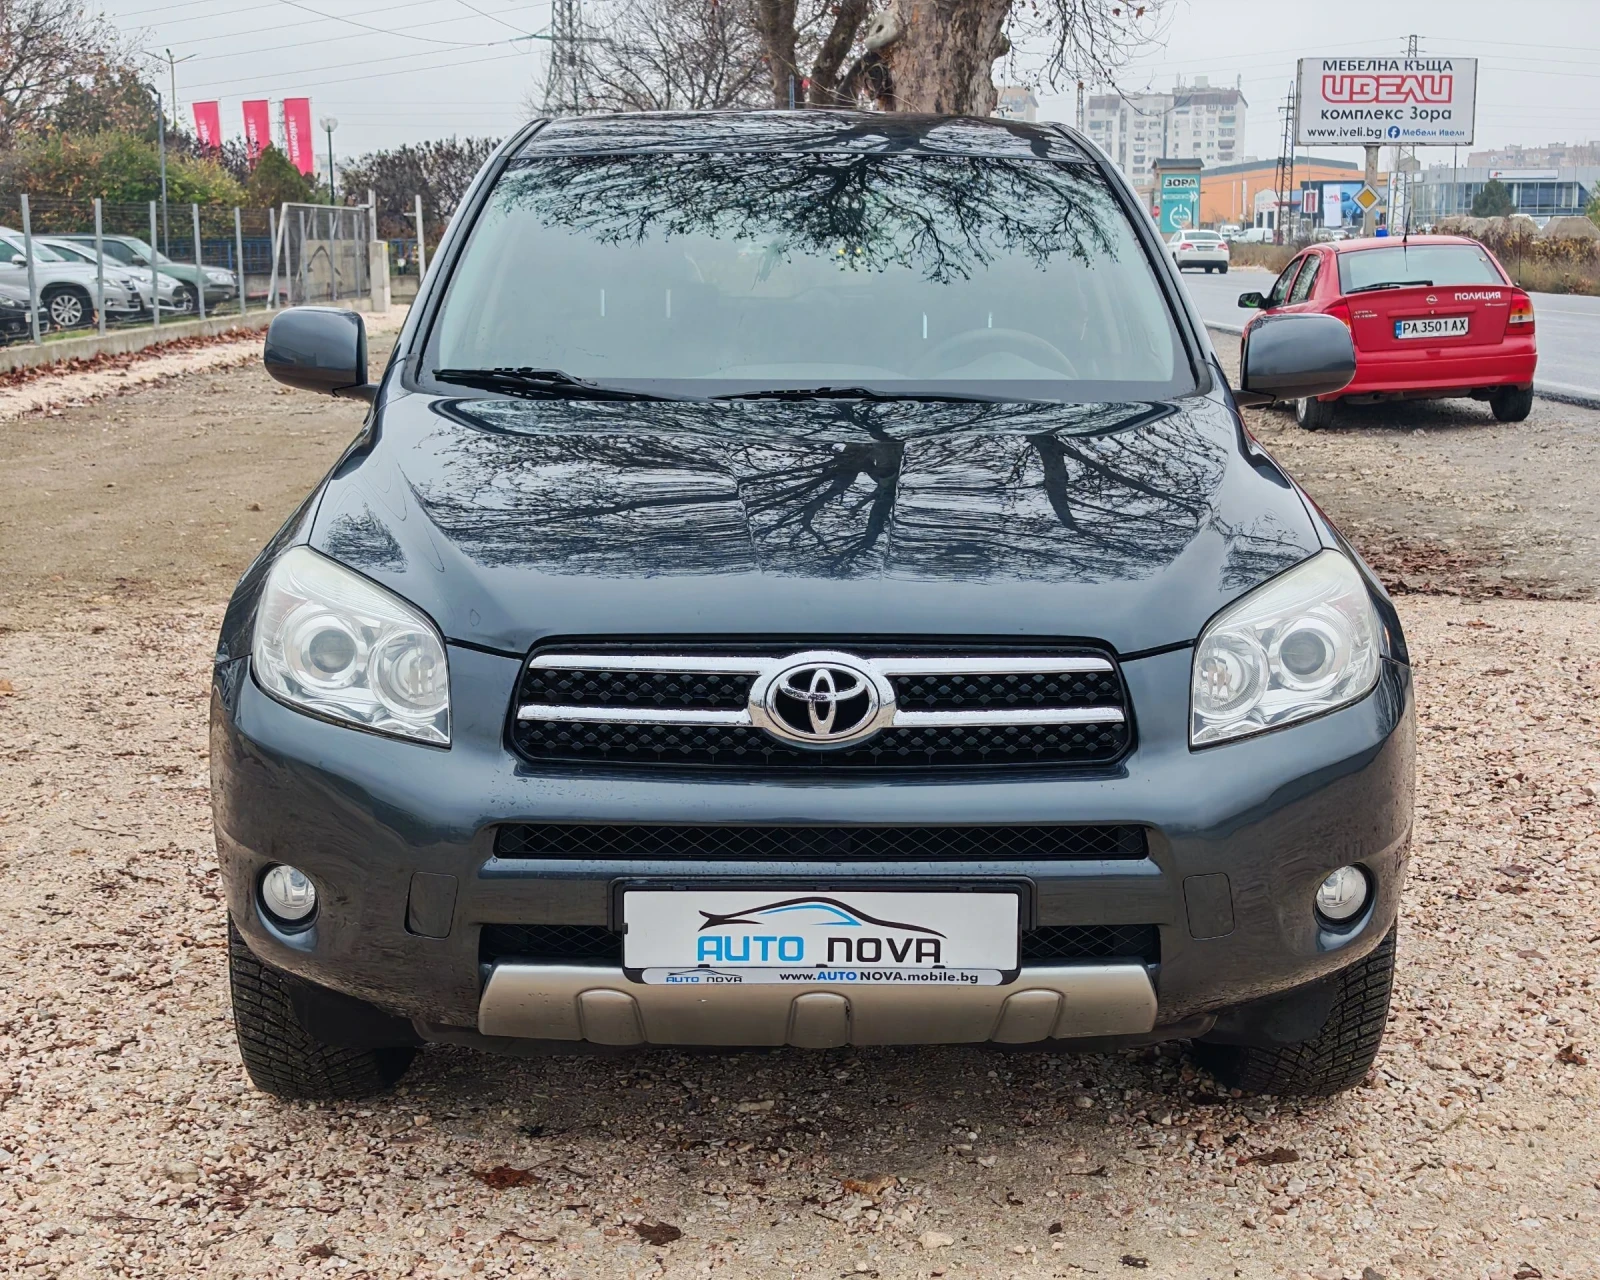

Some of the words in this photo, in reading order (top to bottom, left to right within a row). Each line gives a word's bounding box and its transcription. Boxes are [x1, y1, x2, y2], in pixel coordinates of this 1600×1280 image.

[1322, 60, 1399, 71] МЕБЕЛНА
[1404, 60, 1453, 73] КЪЩА
[1321, 75, 1453, 103] ИВЕЛИ
[1321, 108, 1404, 120] комплекс
[1410, 106, 1452, 123] Зора
[1307, 126, 1382, 139] www.iveli.bg
[1164, 178, 1198, 187] ЗОРА
[1454, 291, 1501, 301] ПОЛИЦИЯ
[697, 936, 804, 962] AUTO
[828, 937, 941, 964] NOVA
